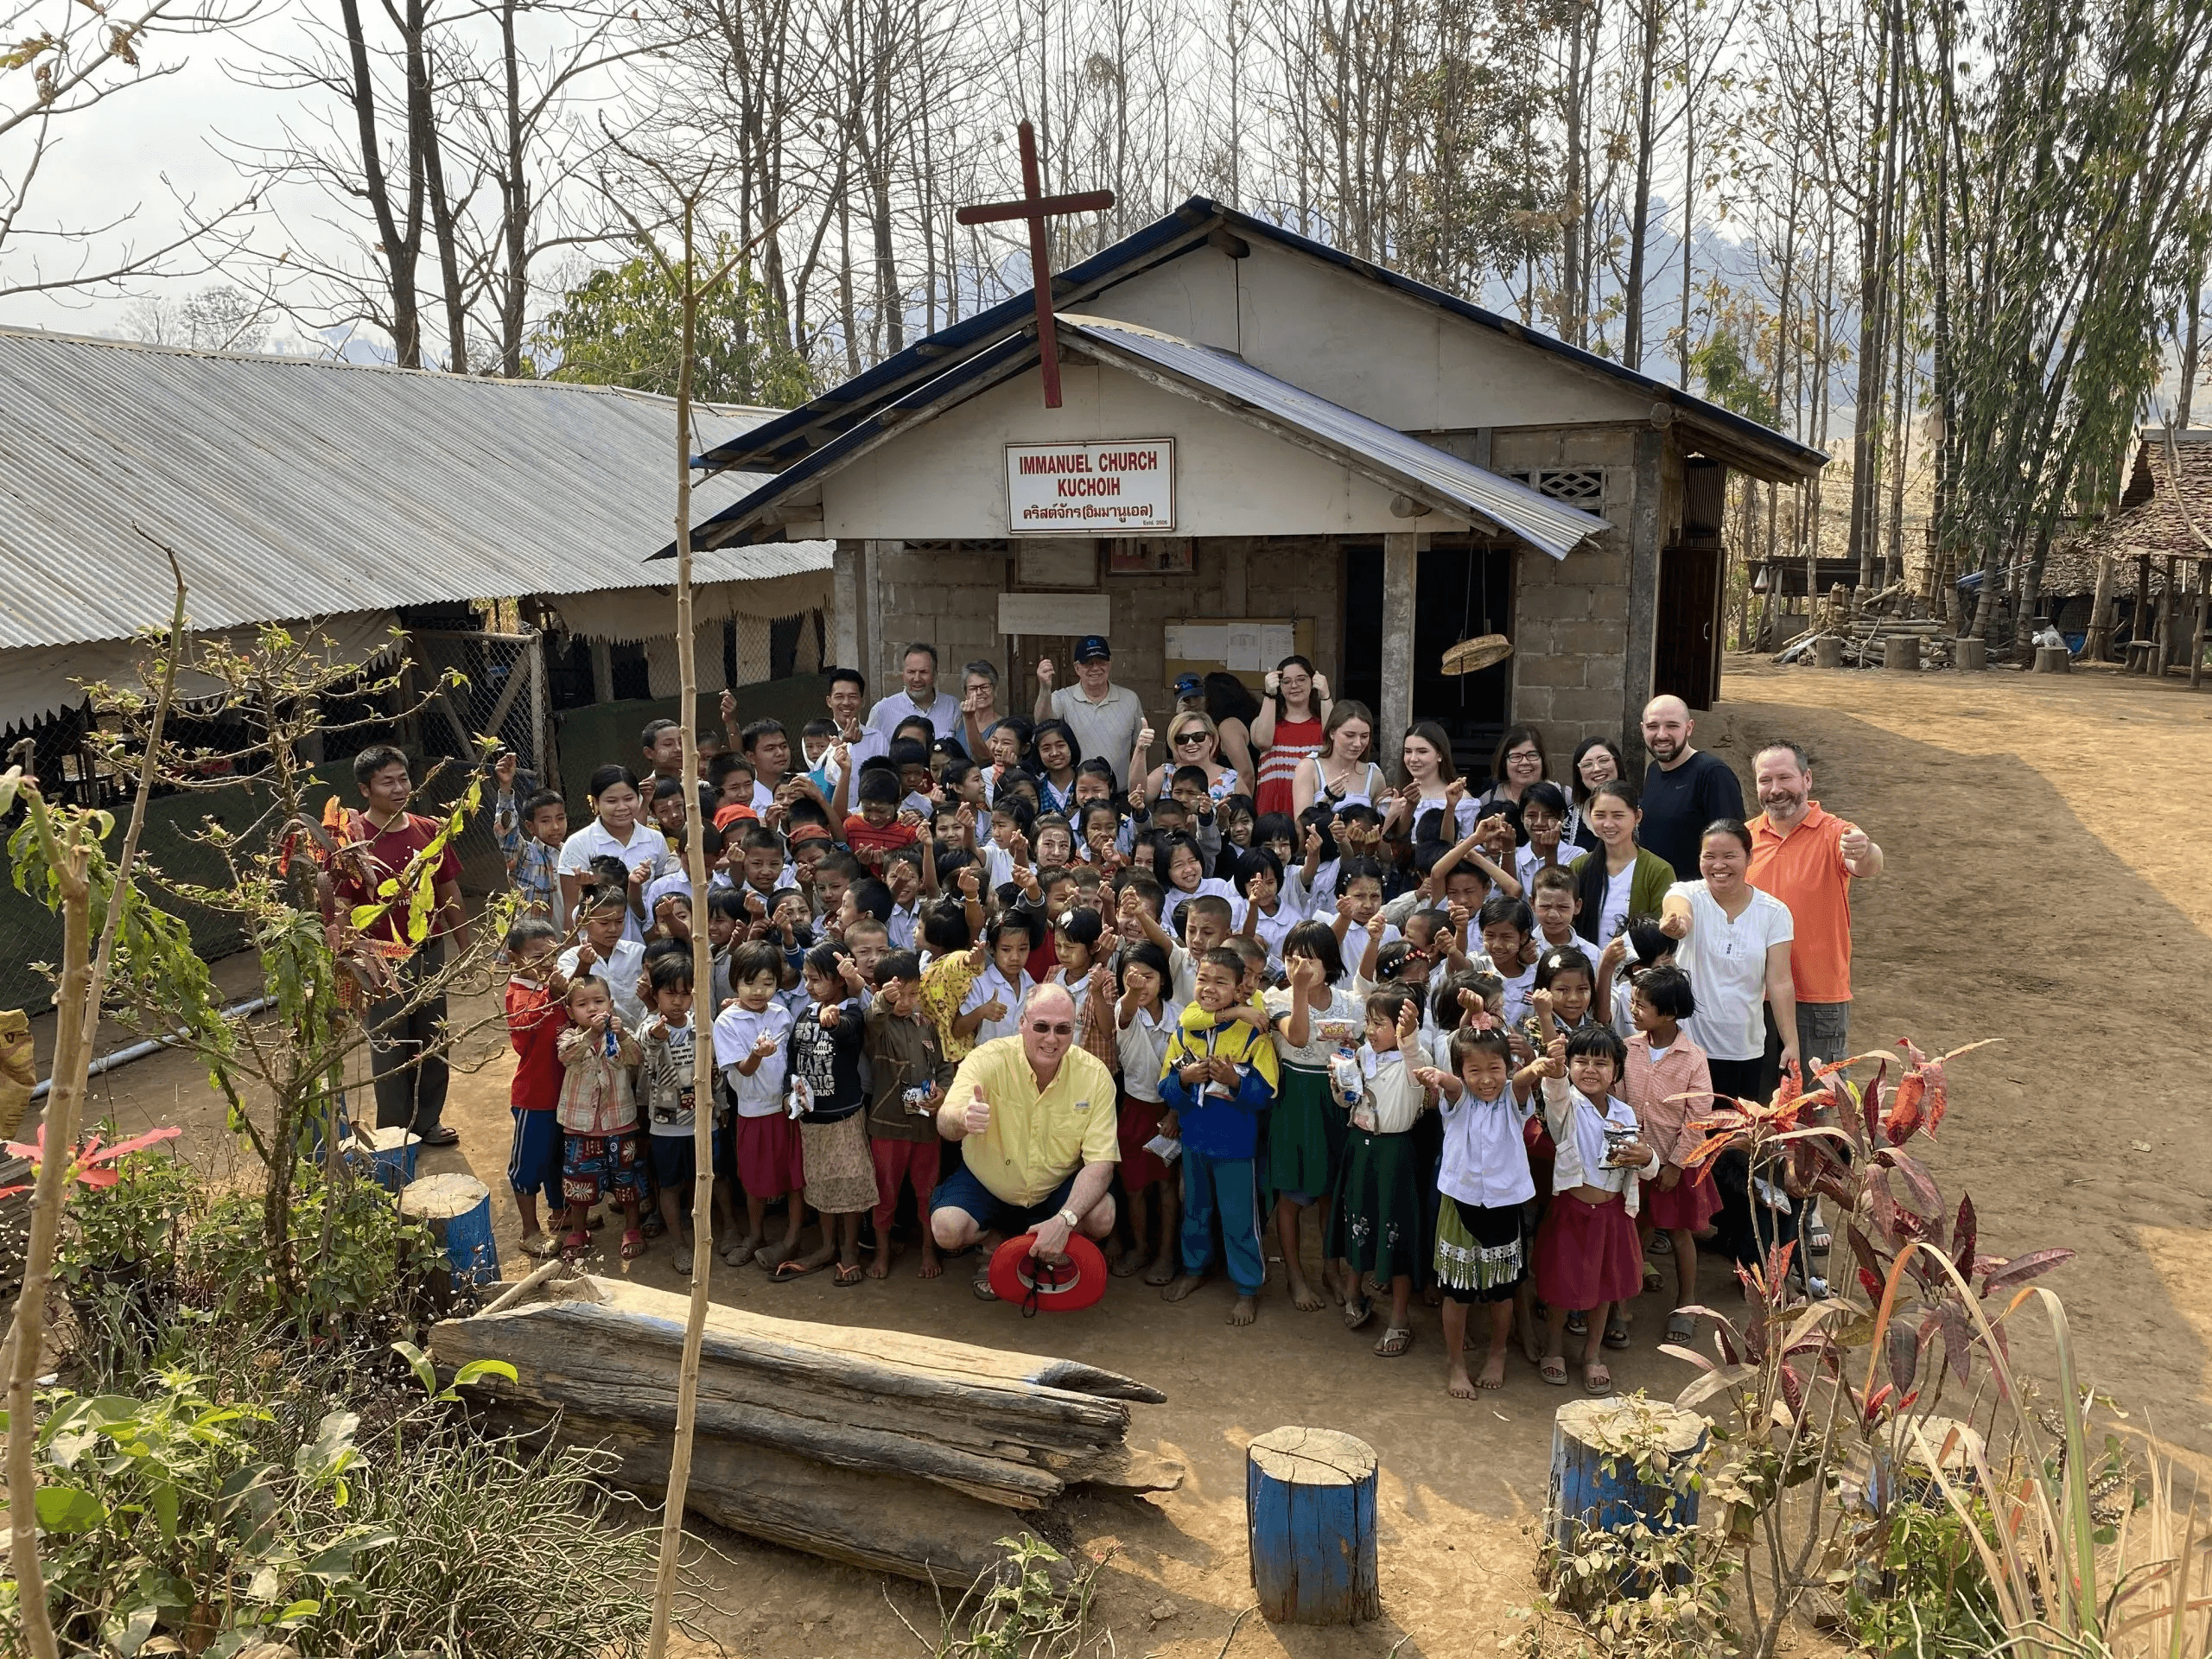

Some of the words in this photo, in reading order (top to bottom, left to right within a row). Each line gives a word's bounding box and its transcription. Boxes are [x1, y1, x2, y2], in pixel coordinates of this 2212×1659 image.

[1020, 454, 1093, 475] IMMANUEL
[1098, 451, 1158, 473] CHURCH
[1058, 477, 1121, 498] KUCHOIH
[1023, 503, 1154, 524] คริสต์จักร(อิมมานูเอล)
